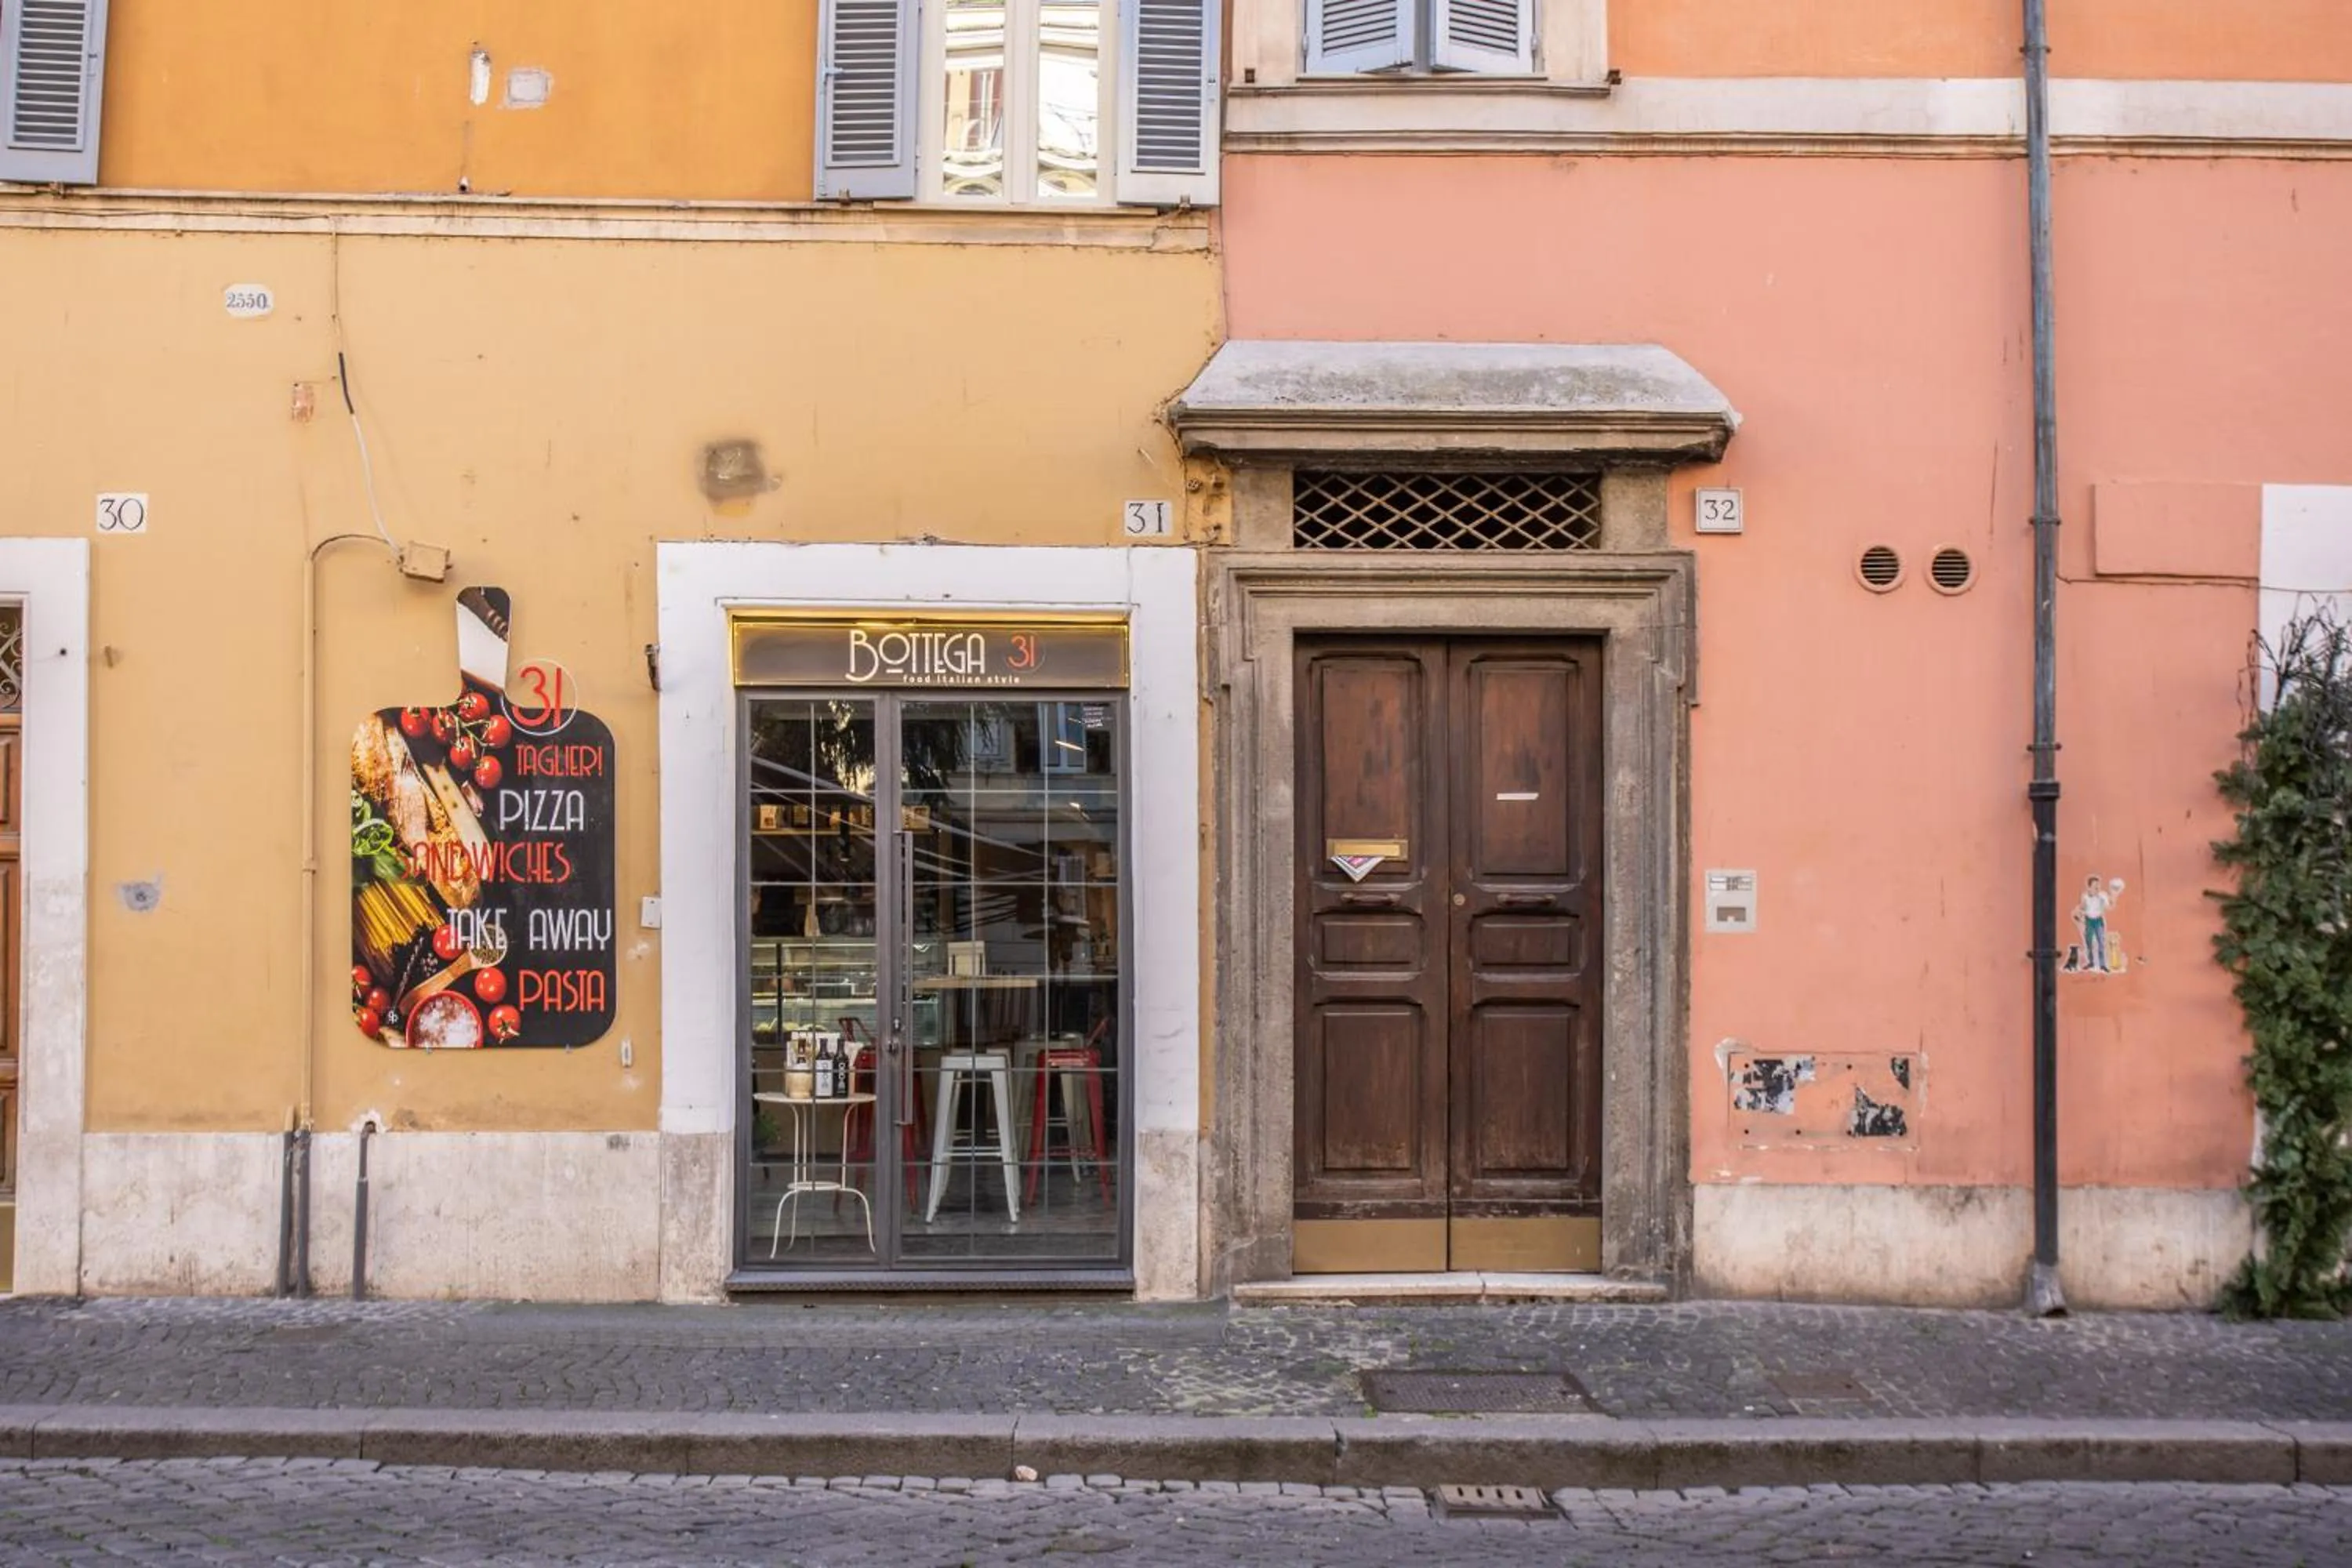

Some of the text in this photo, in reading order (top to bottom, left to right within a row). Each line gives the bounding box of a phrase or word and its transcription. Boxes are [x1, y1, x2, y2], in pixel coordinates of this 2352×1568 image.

[100, 497, 144, 531] 30
[1127, 502, 1164, 534] 31
[1704, 499, 1736, 521] 32
[845, 630, 1035, 682] BOTTEGA 31
[512, 666, 562, 728] 31
[902, 674, 931, 684] food
[986, 674, 1020, 685] style
[516, 744, 602, 778] TAGLIERI
[499, 789, 584, 832] PIZZA
[396, 840, 572, 884] SANDWICHES
[448, 908, 612, 951] TAKE AWAY
[520, 970, 604, 1013] PASTA
